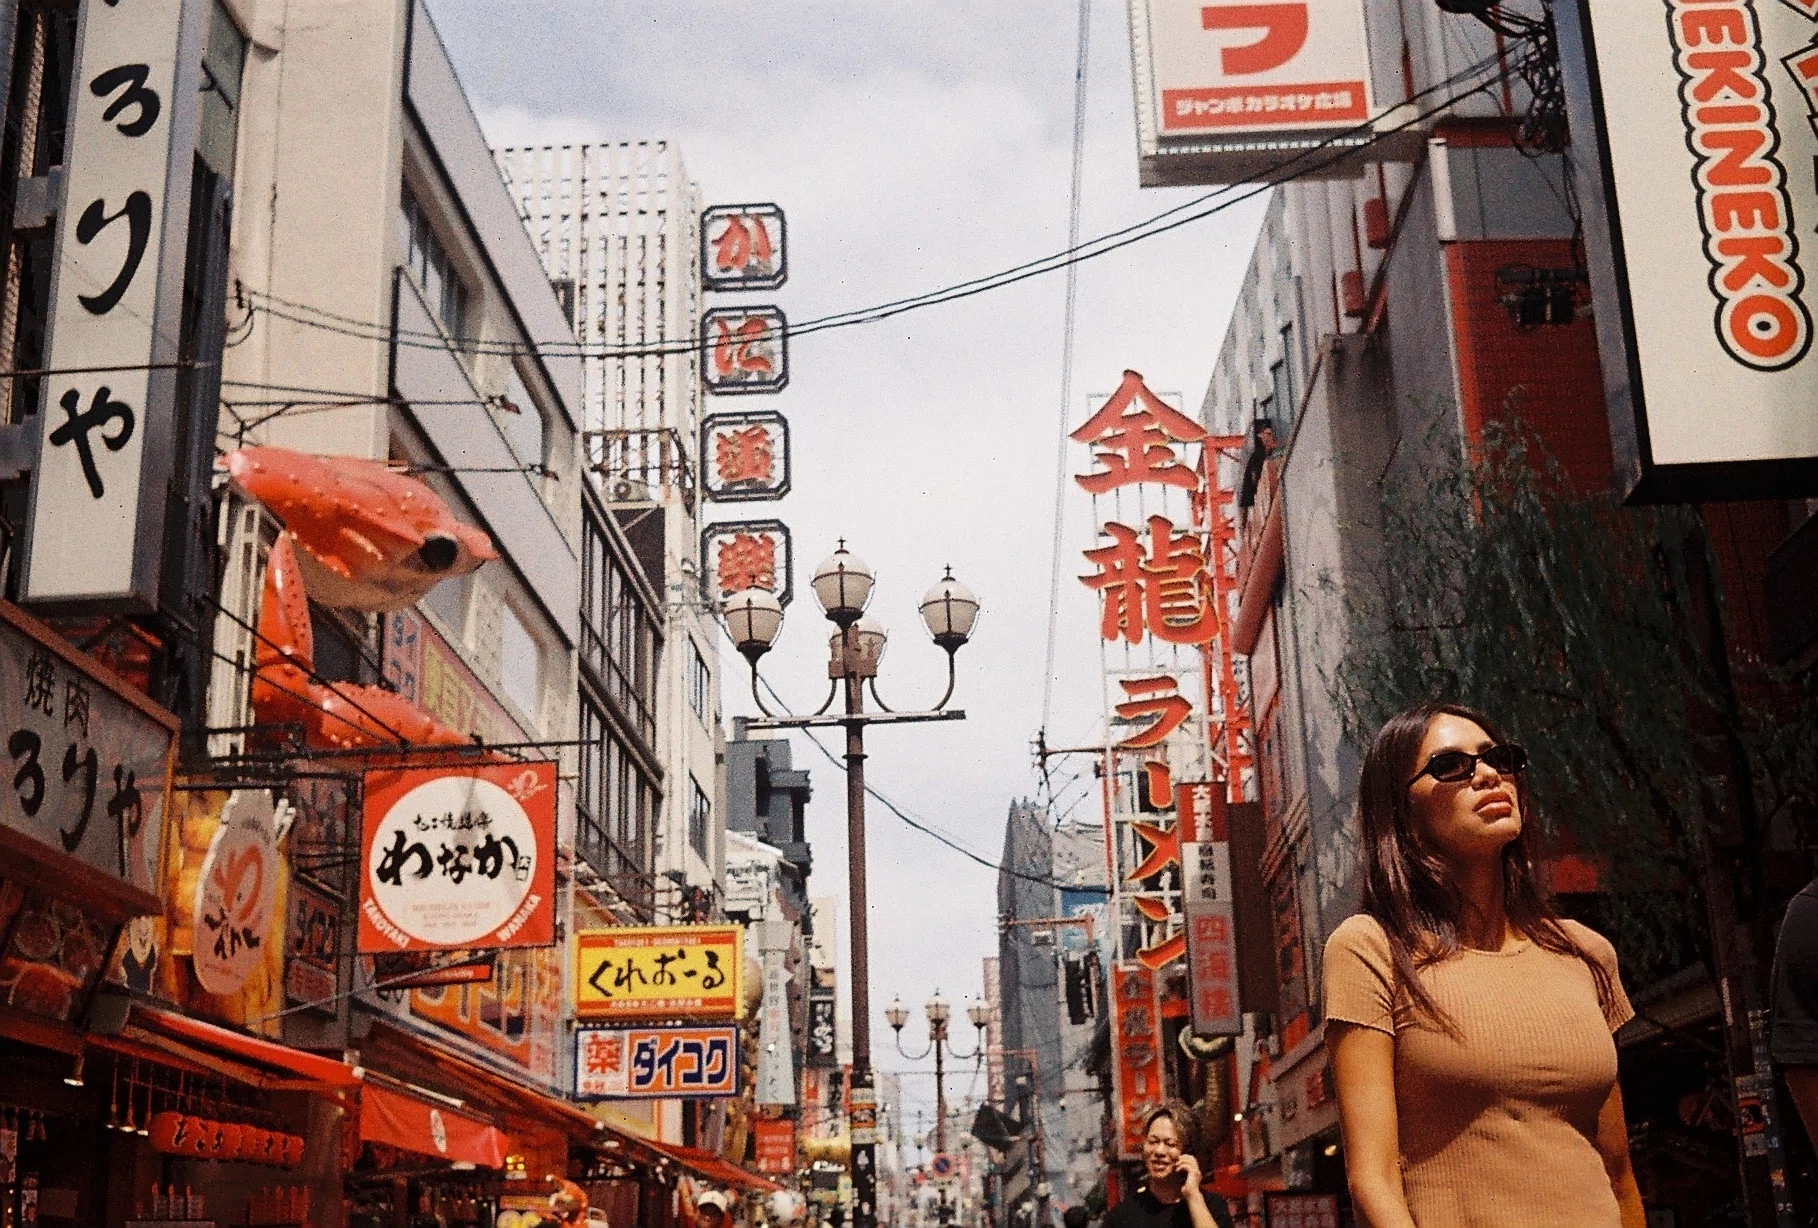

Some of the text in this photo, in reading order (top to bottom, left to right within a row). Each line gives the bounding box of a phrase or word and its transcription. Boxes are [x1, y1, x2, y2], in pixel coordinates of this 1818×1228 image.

[1674, 0, 1803, 362] EKINEKO
[49, 0, 161, 498] ろりや
[25, 650, 90, 737] 焼肉
[9, 729, 142, 877] ろりや
[376, 830, 519, 886] わなか
[363, 898, 411, 949] TAKOYAKI
[496, 894, 542, 942] WANAKA
[589, 948, 724, 997] くれおーる
[634, 1037, 728, 1086] ダイコク
